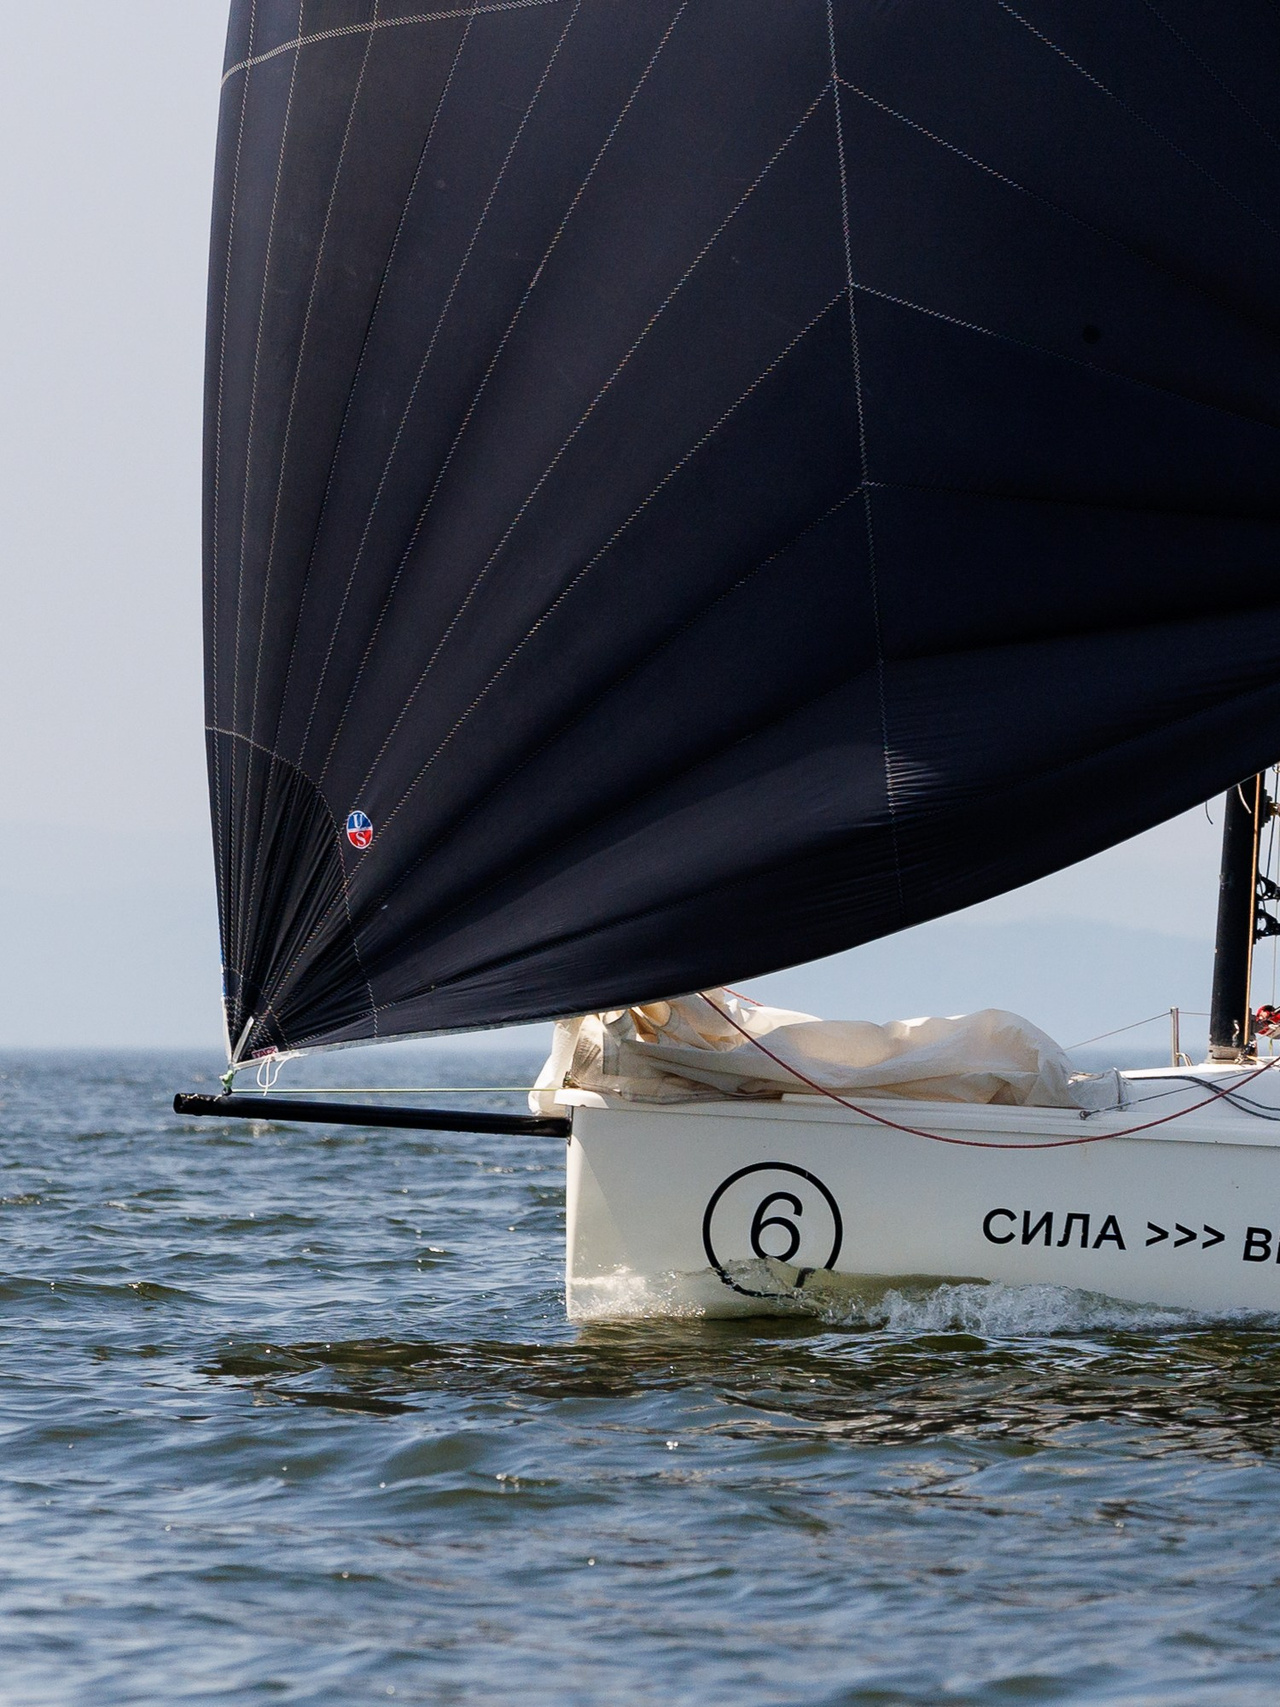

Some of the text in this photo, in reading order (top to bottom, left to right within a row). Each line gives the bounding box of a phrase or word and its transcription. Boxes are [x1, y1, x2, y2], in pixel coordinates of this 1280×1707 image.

[252, 1045, 278, 1059] TACK
[750, 1191, 803, 1264] 6
[982, 1208, 1127, 1251] СИЛА
